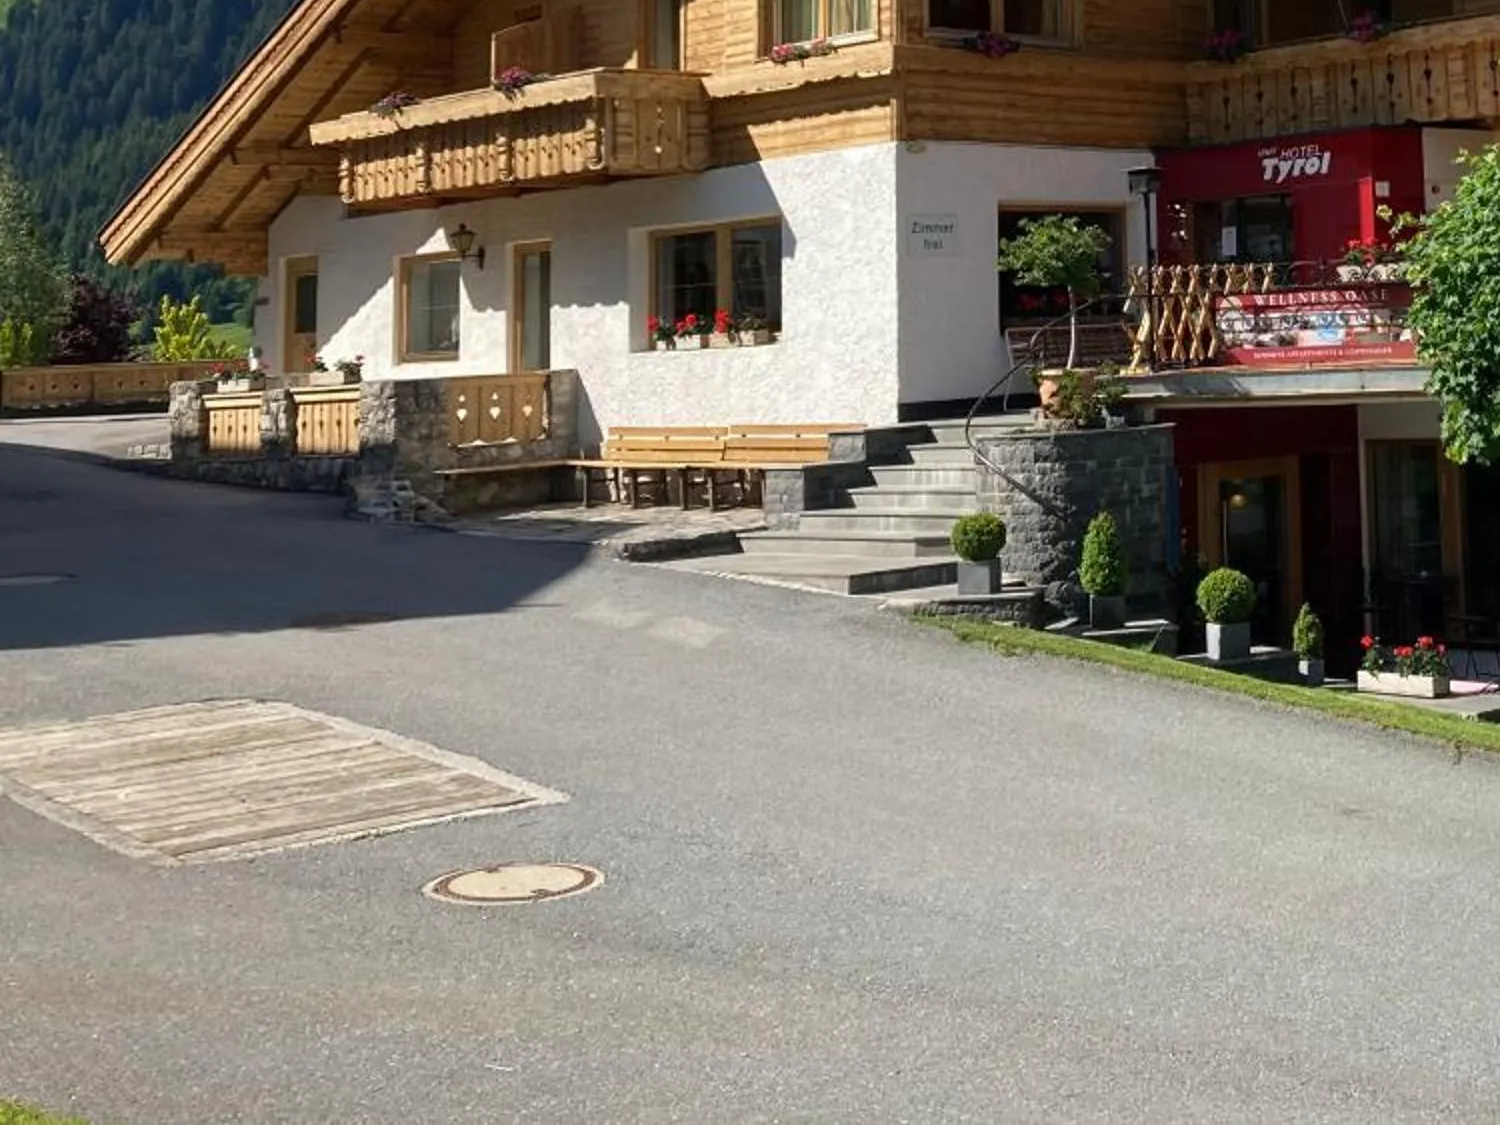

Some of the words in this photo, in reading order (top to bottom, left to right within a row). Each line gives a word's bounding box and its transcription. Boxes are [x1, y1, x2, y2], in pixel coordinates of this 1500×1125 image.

[1280, 143, 1323, 158] HOTEL
[1262, 150, 1332, 184] Tyrol
[911, 220, 954, 235] Zimmer
[1253, 290, 1337, 306] WELLNESS
[1344, 288, 1389, 304] OASE
